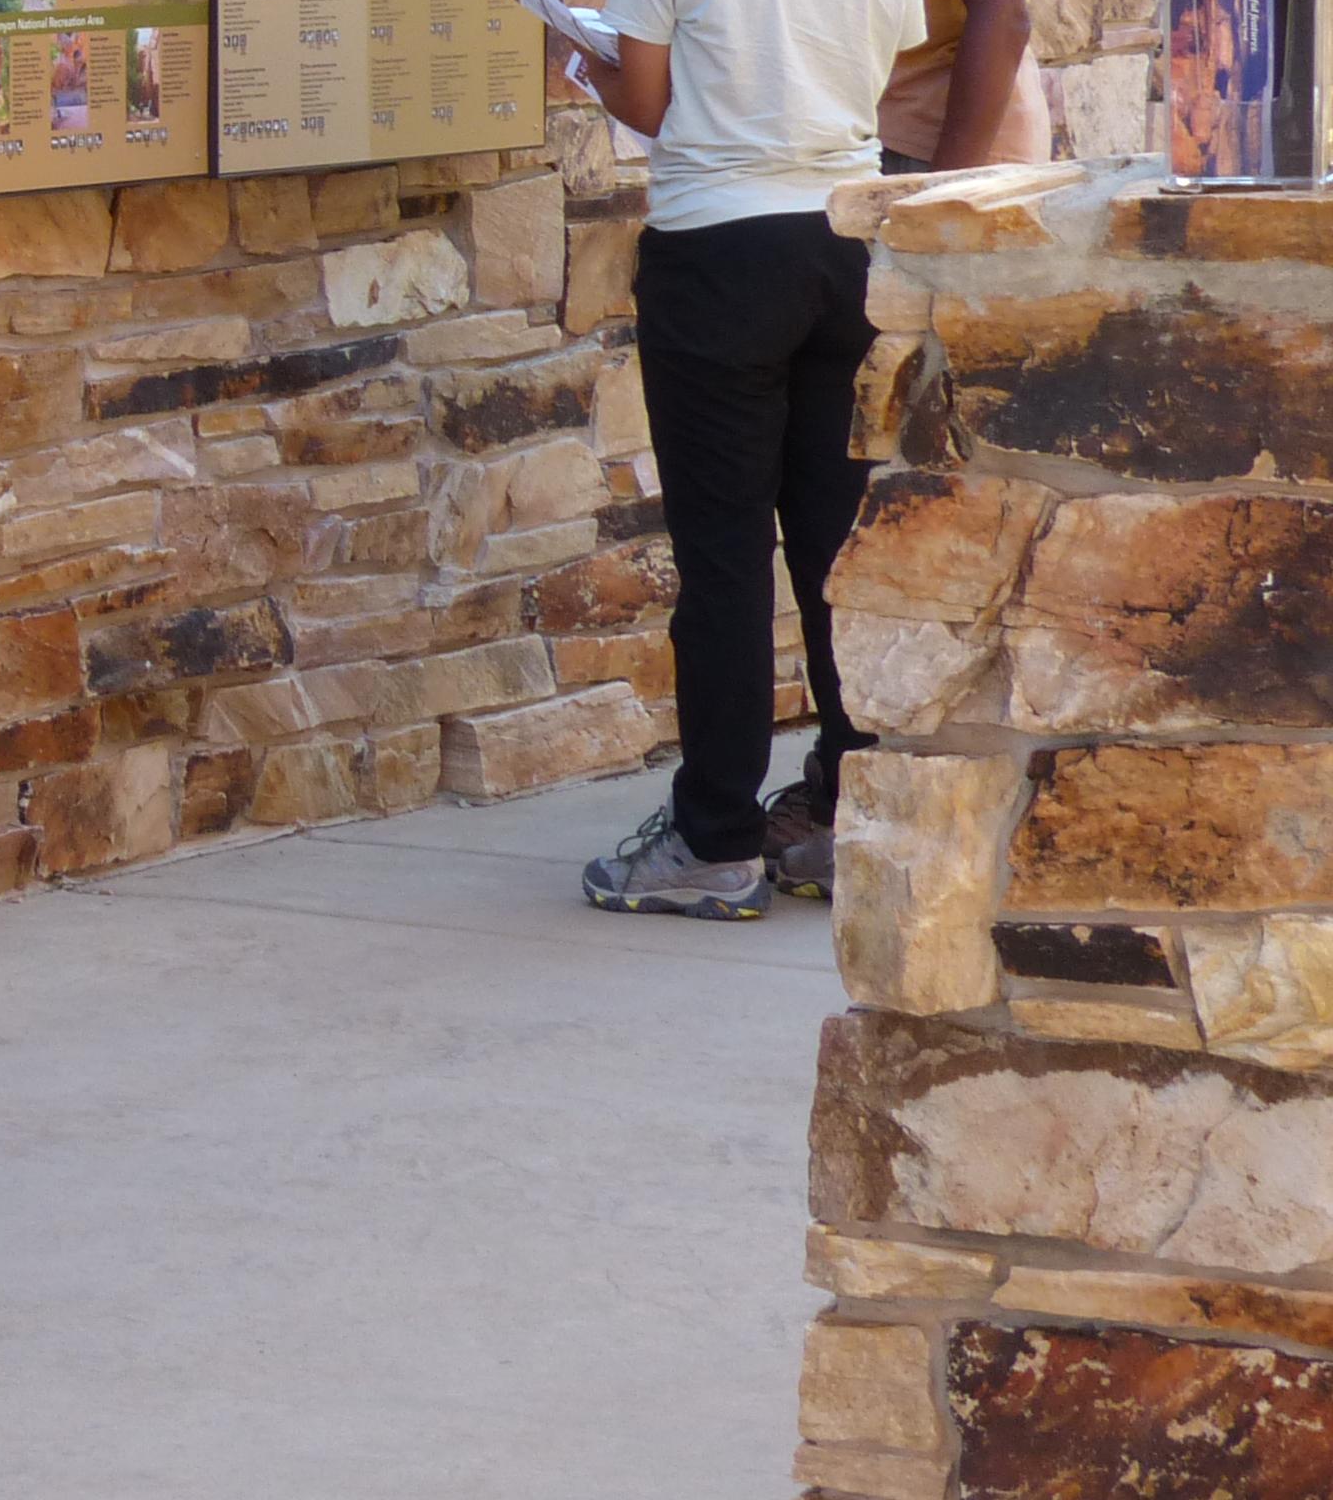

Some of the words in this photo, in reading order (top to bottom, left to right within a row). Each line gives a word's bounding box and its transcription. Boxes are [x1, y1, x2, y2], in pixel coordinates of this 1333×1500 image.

[17, 17, 48, 31] National
[49, 16, 87, 29] Recreation
[87, 15, 105, 27] Area
